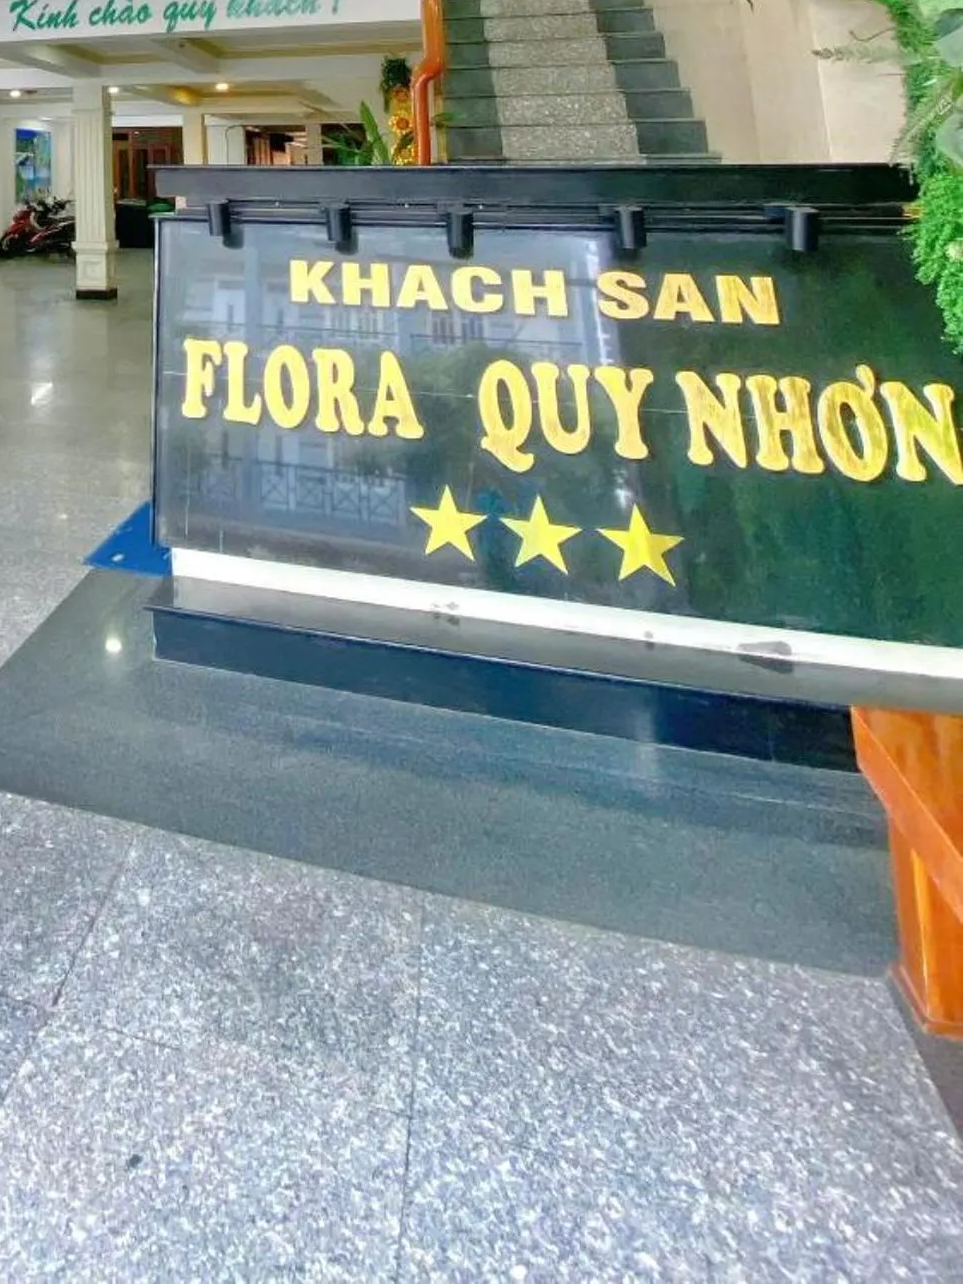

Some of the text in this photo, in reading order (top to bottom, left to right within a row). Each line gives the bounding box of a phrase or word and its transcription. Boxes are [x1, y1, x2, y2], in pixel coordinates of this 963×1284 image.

[288, 259, 782, 326] KHACH SAN
[181, 338, 963, 486] FLORA QUY NHƠN
